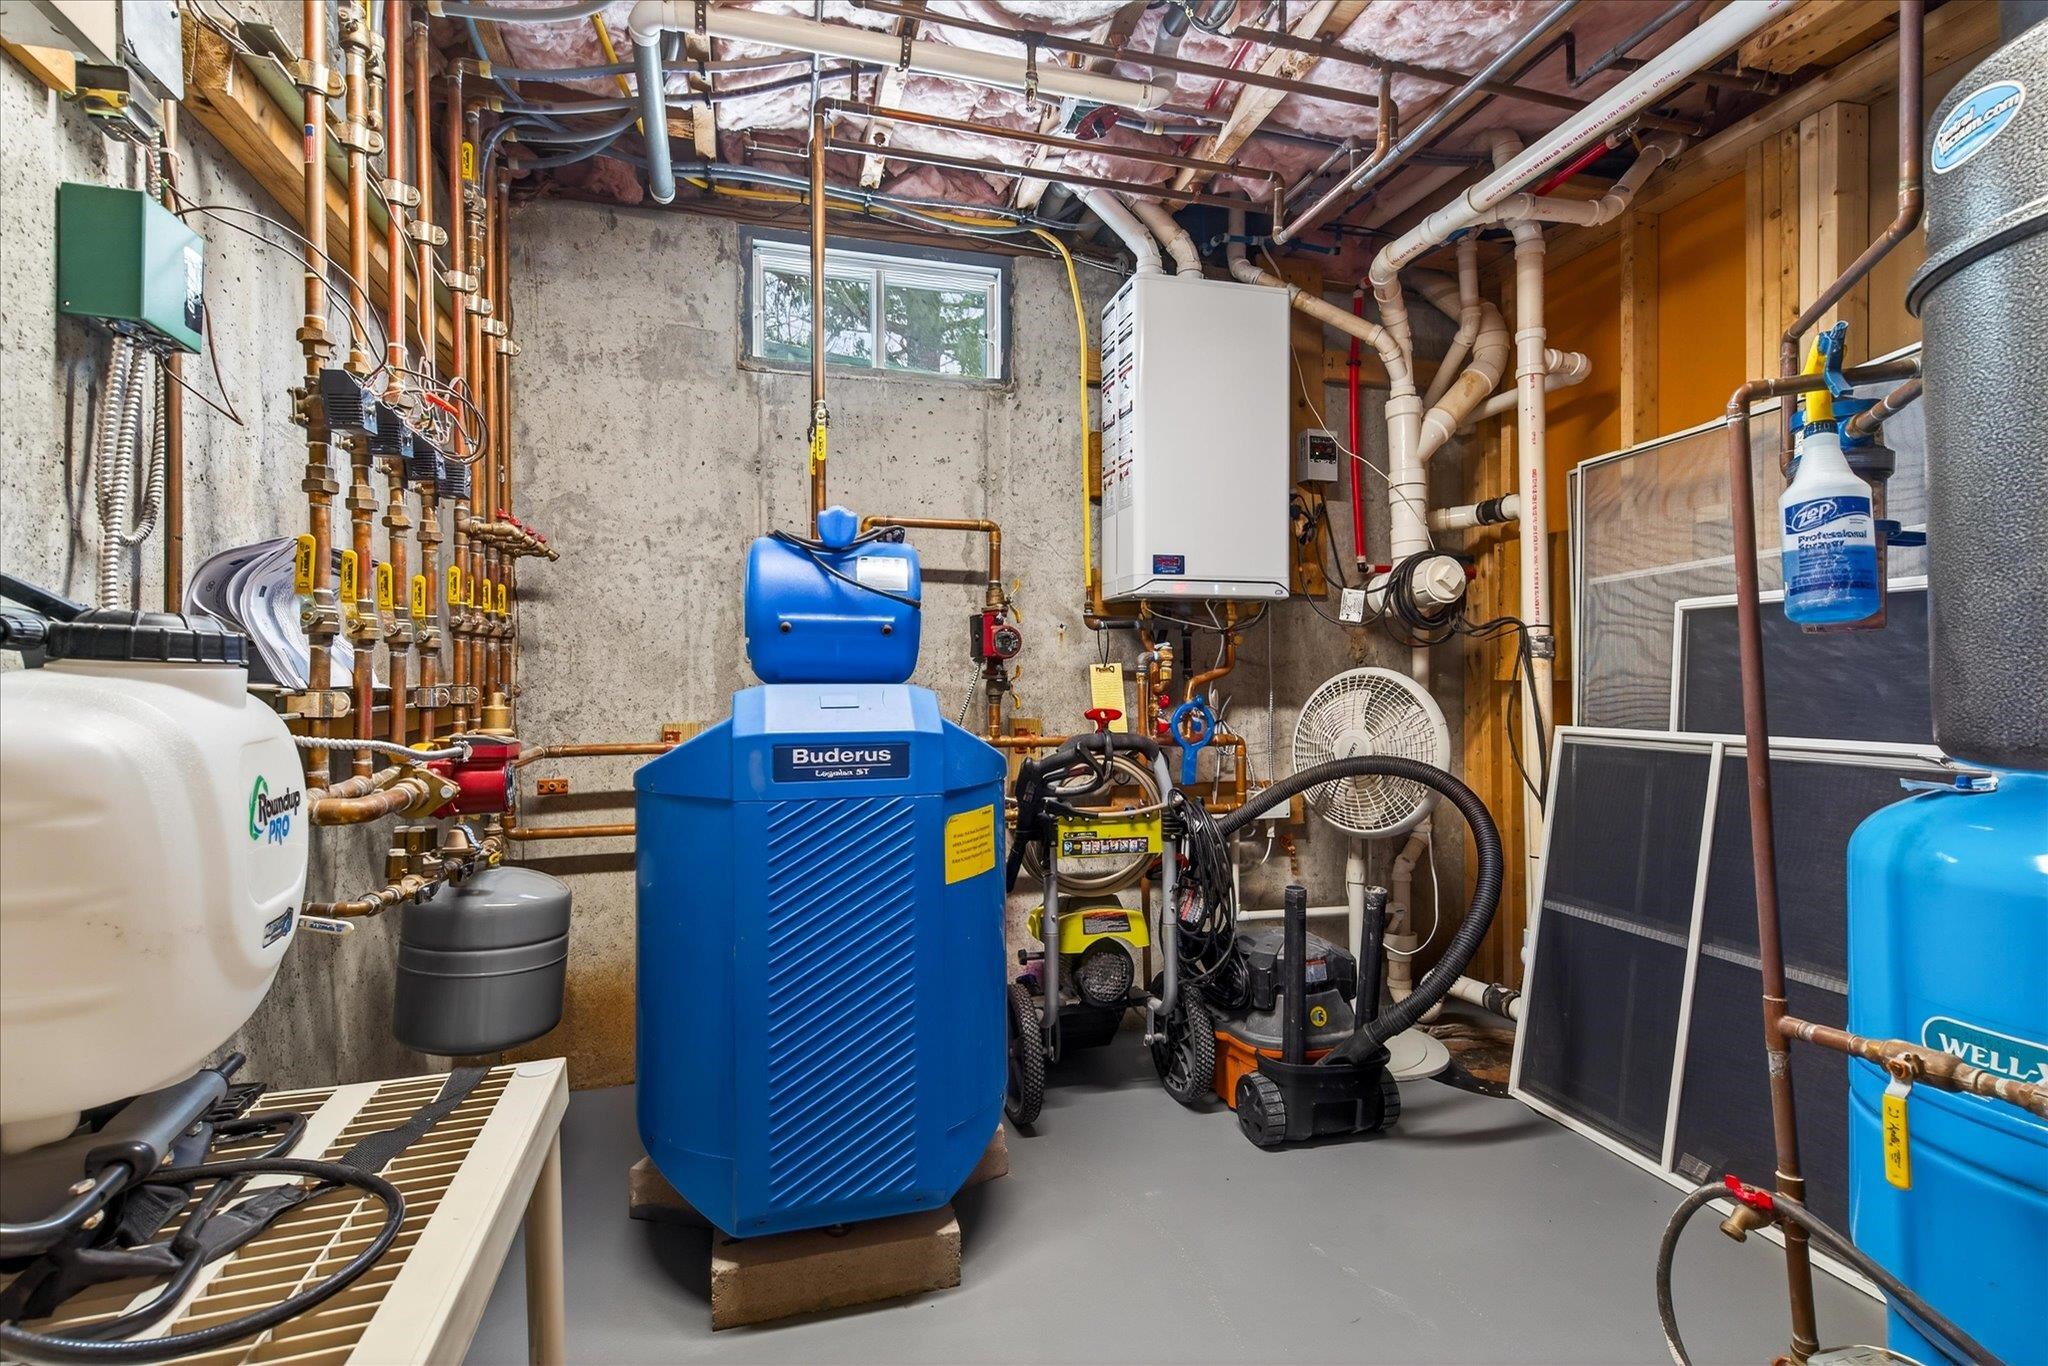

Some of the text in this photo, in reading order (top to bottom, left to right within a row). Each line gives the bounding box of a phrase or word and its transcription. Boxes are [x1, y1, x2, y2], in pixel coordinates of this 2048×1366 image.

[1798, 529, 1867, 544] Professional
[792, 747, 892, 765] Buderus
[855, 767, 870, 776] ST
[257, 786, 301, 826] Roundup
[268, 814, 290, 845] PRO
